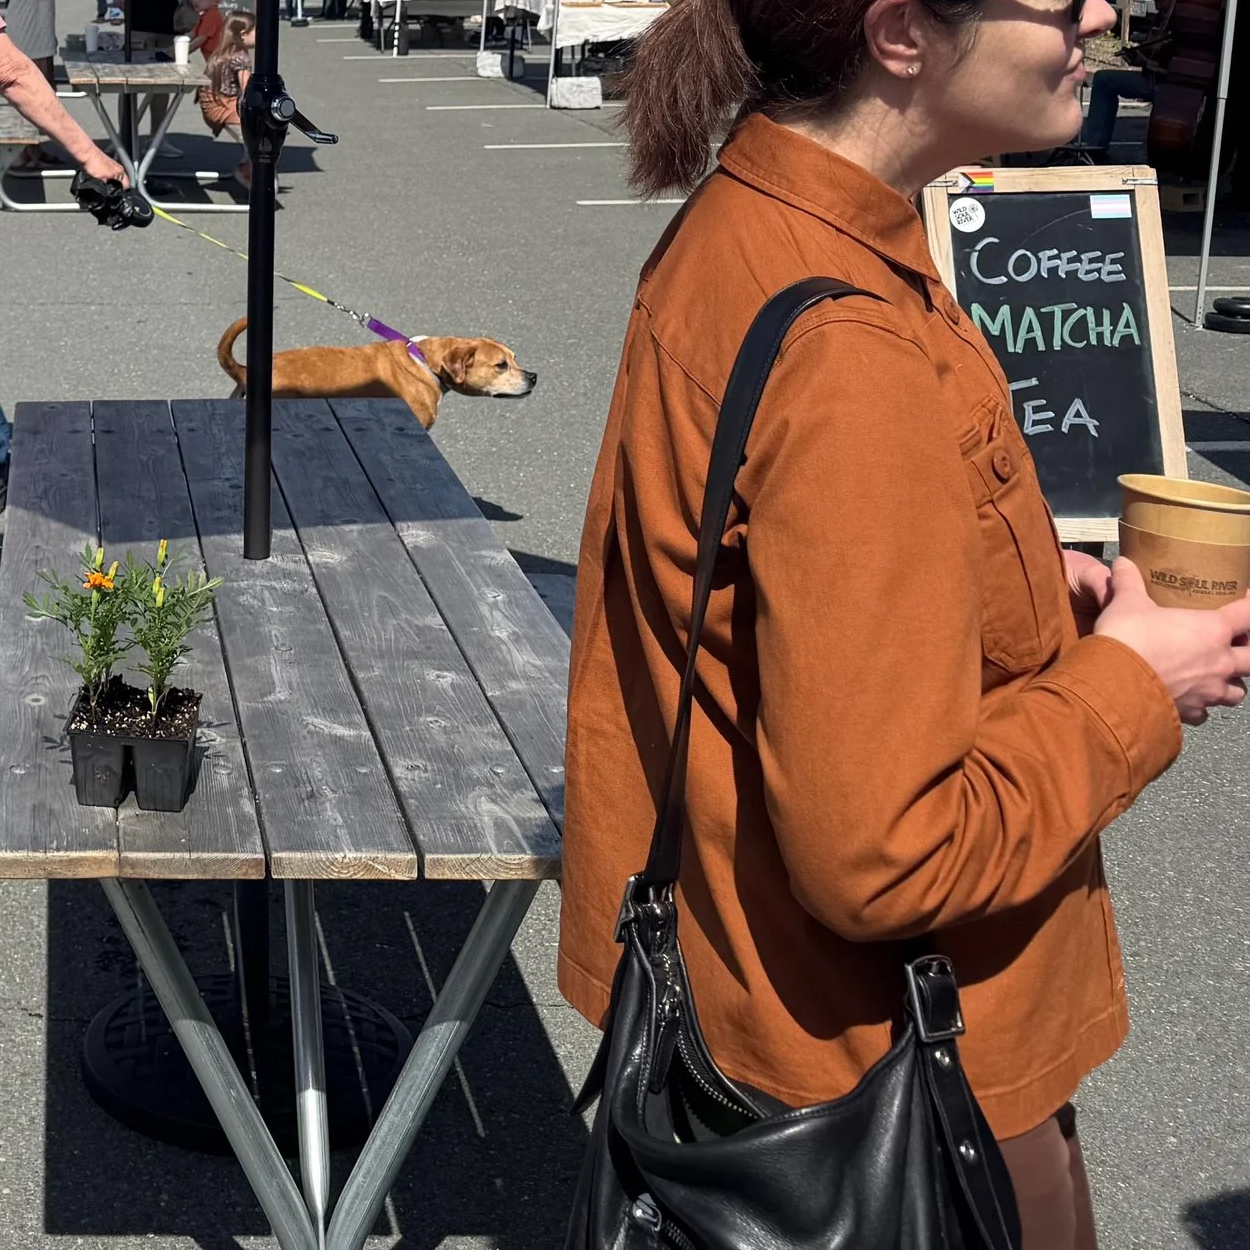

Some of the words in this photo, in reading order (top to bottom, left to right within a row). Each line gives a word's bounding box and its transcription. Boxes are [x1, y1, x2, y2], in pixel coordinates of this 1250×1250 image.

[970, 237, 1127, 285] COFFEE
[971, 302, 1141, 353] MATCHA
[1150, 569, 1177, 583] WILD
[1212, 580, 1238, 591] RIVER
